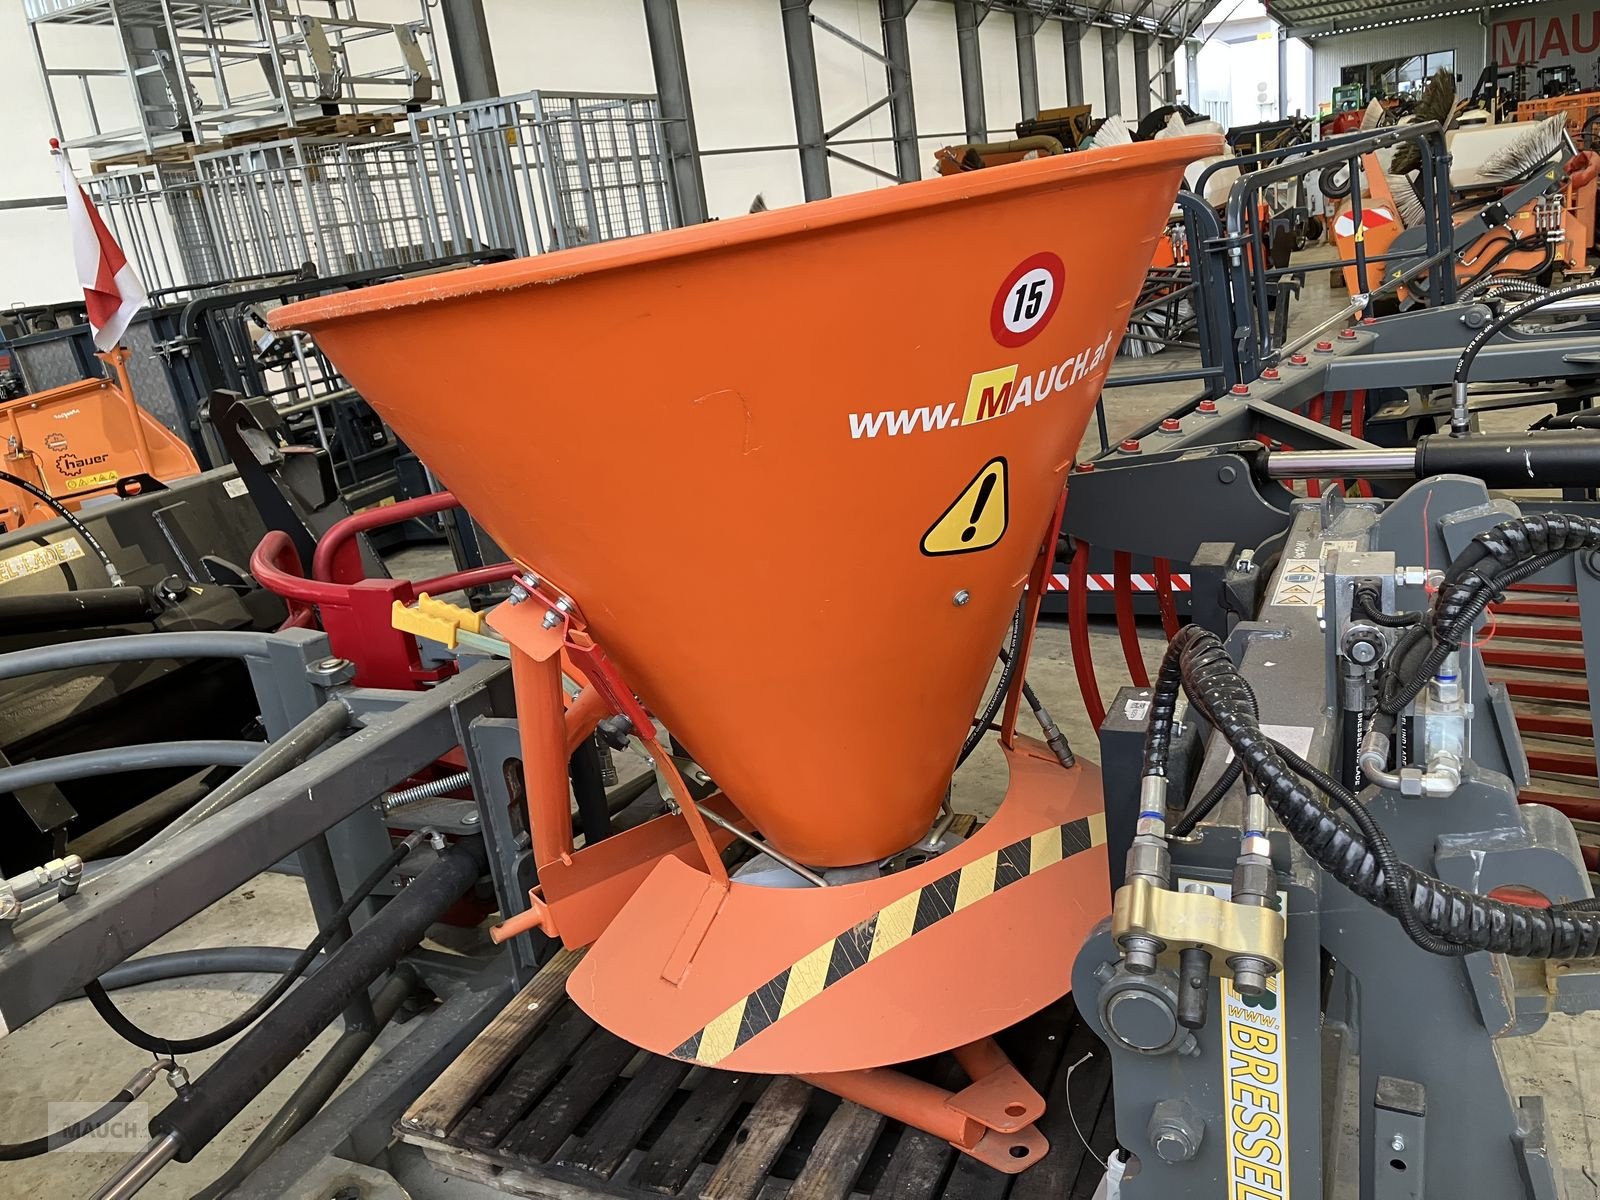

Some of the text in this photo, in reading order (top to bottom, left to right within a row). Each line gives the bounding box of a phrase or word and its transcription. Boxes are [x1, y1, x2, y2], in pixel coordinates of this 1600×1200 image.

[1491, 11, 1600, 67] MAU
[1013, 279, 1046, 323] 15
[848, 330, 1113, 439] www.MAUCH.at
[65, 454, 109, 470] hauer
[1229, 1004, 1280, 1030] www.
